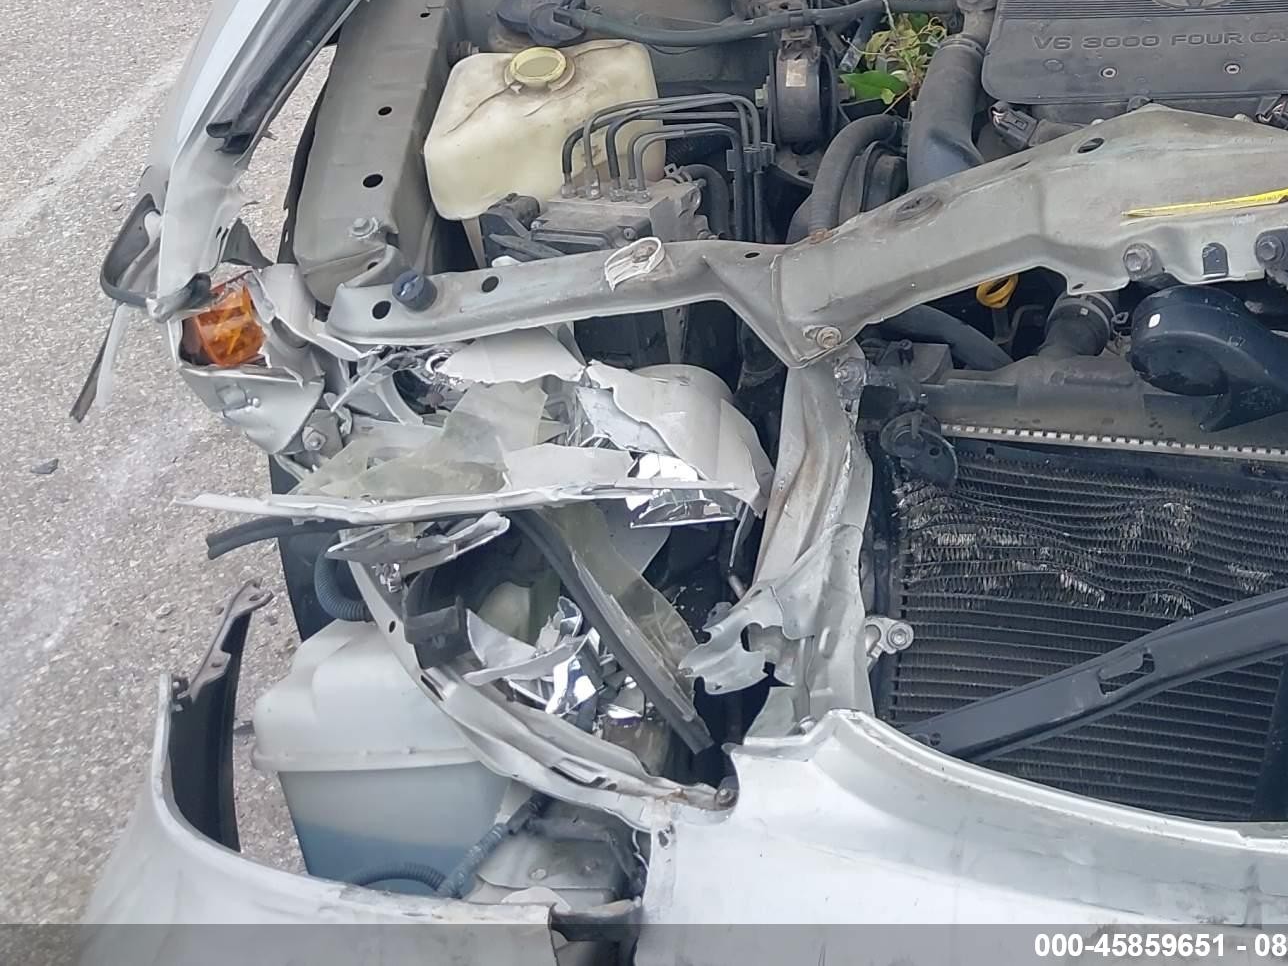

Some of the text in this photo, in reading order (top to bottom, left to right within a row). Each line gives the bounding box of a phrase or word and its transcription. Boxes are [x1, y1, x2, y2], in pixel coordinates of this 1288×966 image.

[1034, 35, 1072, 50] V6
[1082, 35, 1160, 49] 3000
[1171, 33, 1243, 46] FOUR
